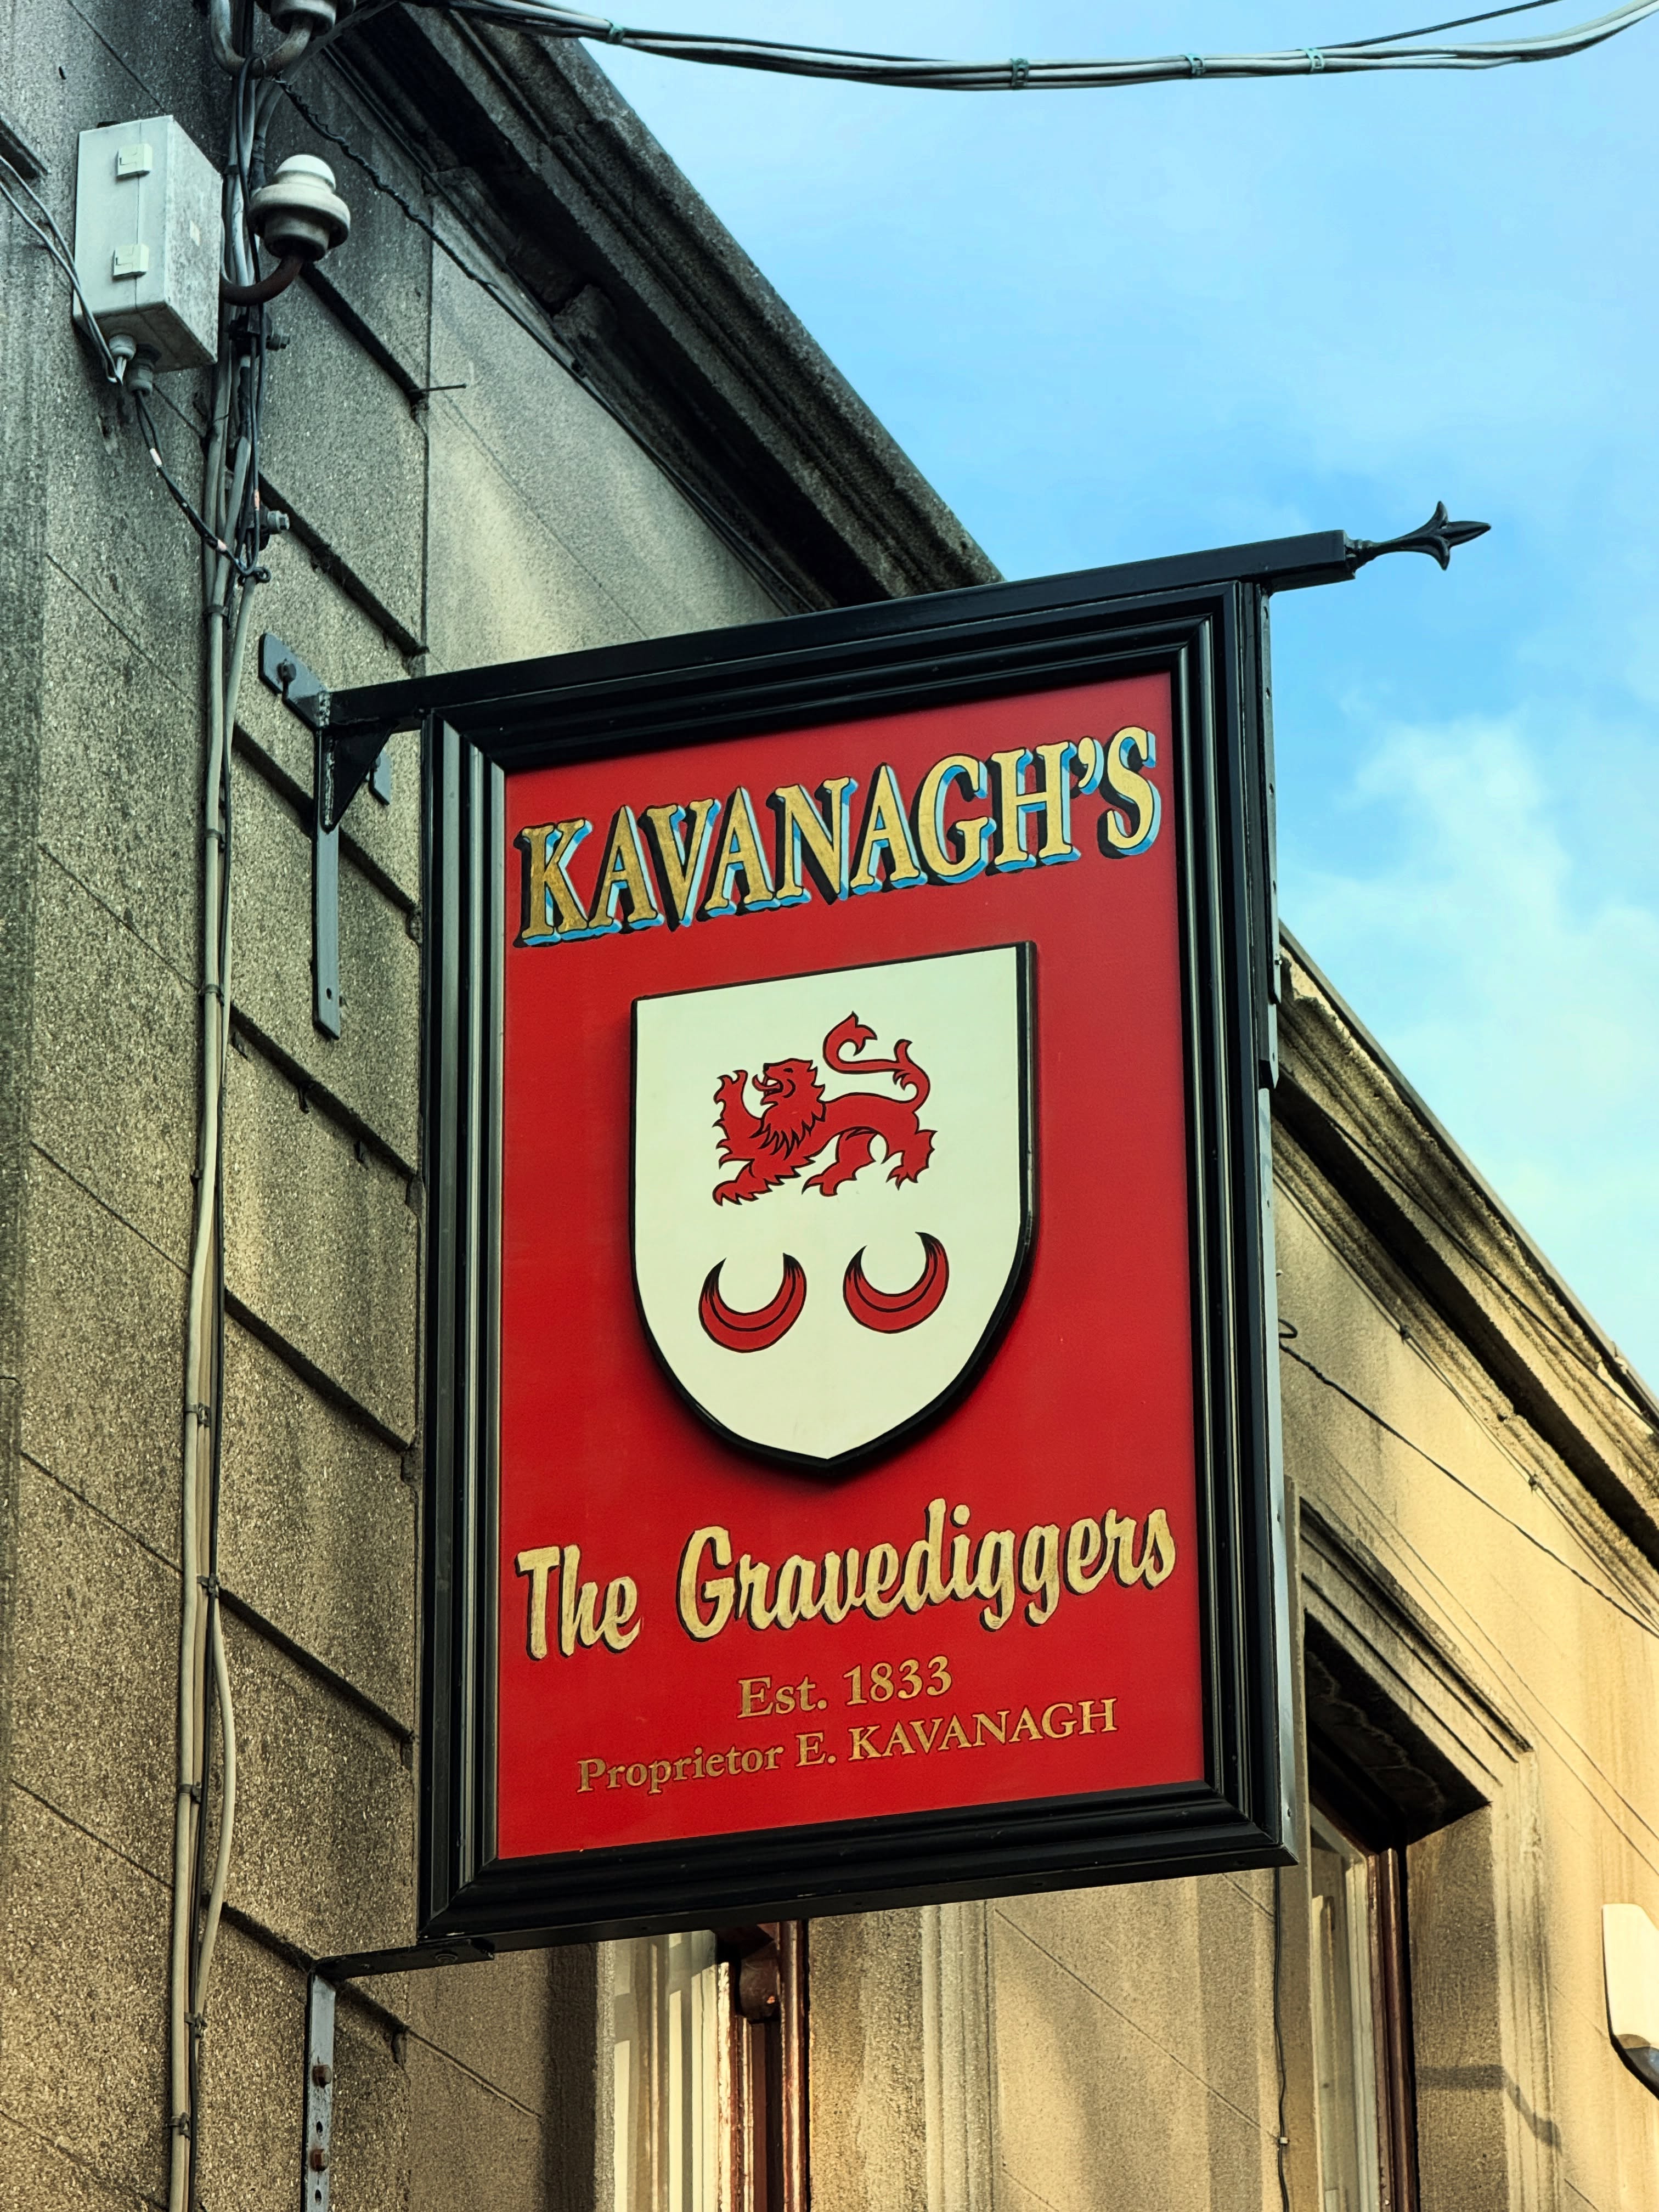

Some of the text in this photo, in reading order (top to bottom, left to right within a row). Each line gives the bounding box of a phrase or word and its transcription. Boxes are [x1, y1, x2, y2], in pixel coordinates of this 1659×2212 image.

[514, 725, 1161, 948] KAVANAGH'S
[515, 1497, 1176, 1661] The Gravediggers
[576, 1697, 1118, 1795] Proprietor E. KAVANAGH
[737, 1655, 953, 1720] Est. 1833
